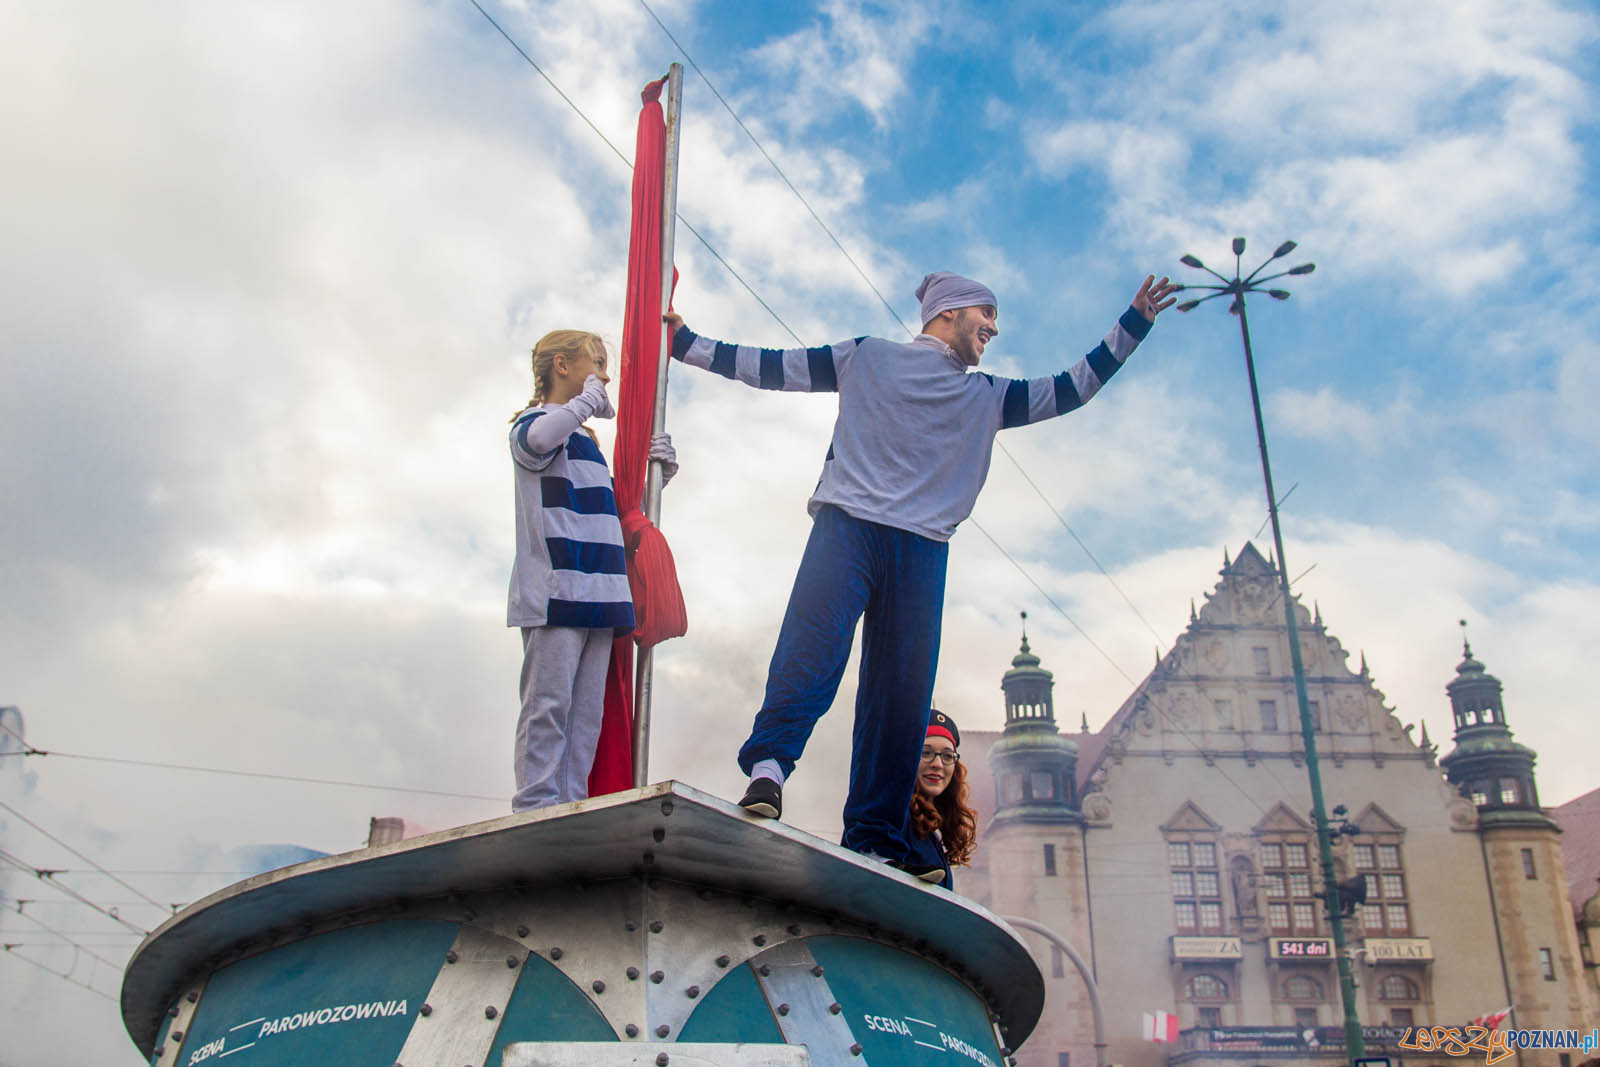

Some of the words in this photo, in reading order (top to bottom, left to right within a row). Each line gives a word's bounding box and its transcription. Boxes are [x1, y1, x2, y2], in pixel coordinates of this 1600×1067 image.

[1219, 942, 1240, 953] ZA
[1282, 942, 1304, 955] 541
[1306, 942, 1328, 955] dni
[1395, 944, 1424, 957] LAT
[863, 1013, 913, 1037] SCENA
[188, 1036, 226, 1067] SCENA
[257, 999, 408, 1039] PAROWOZOWNIA
